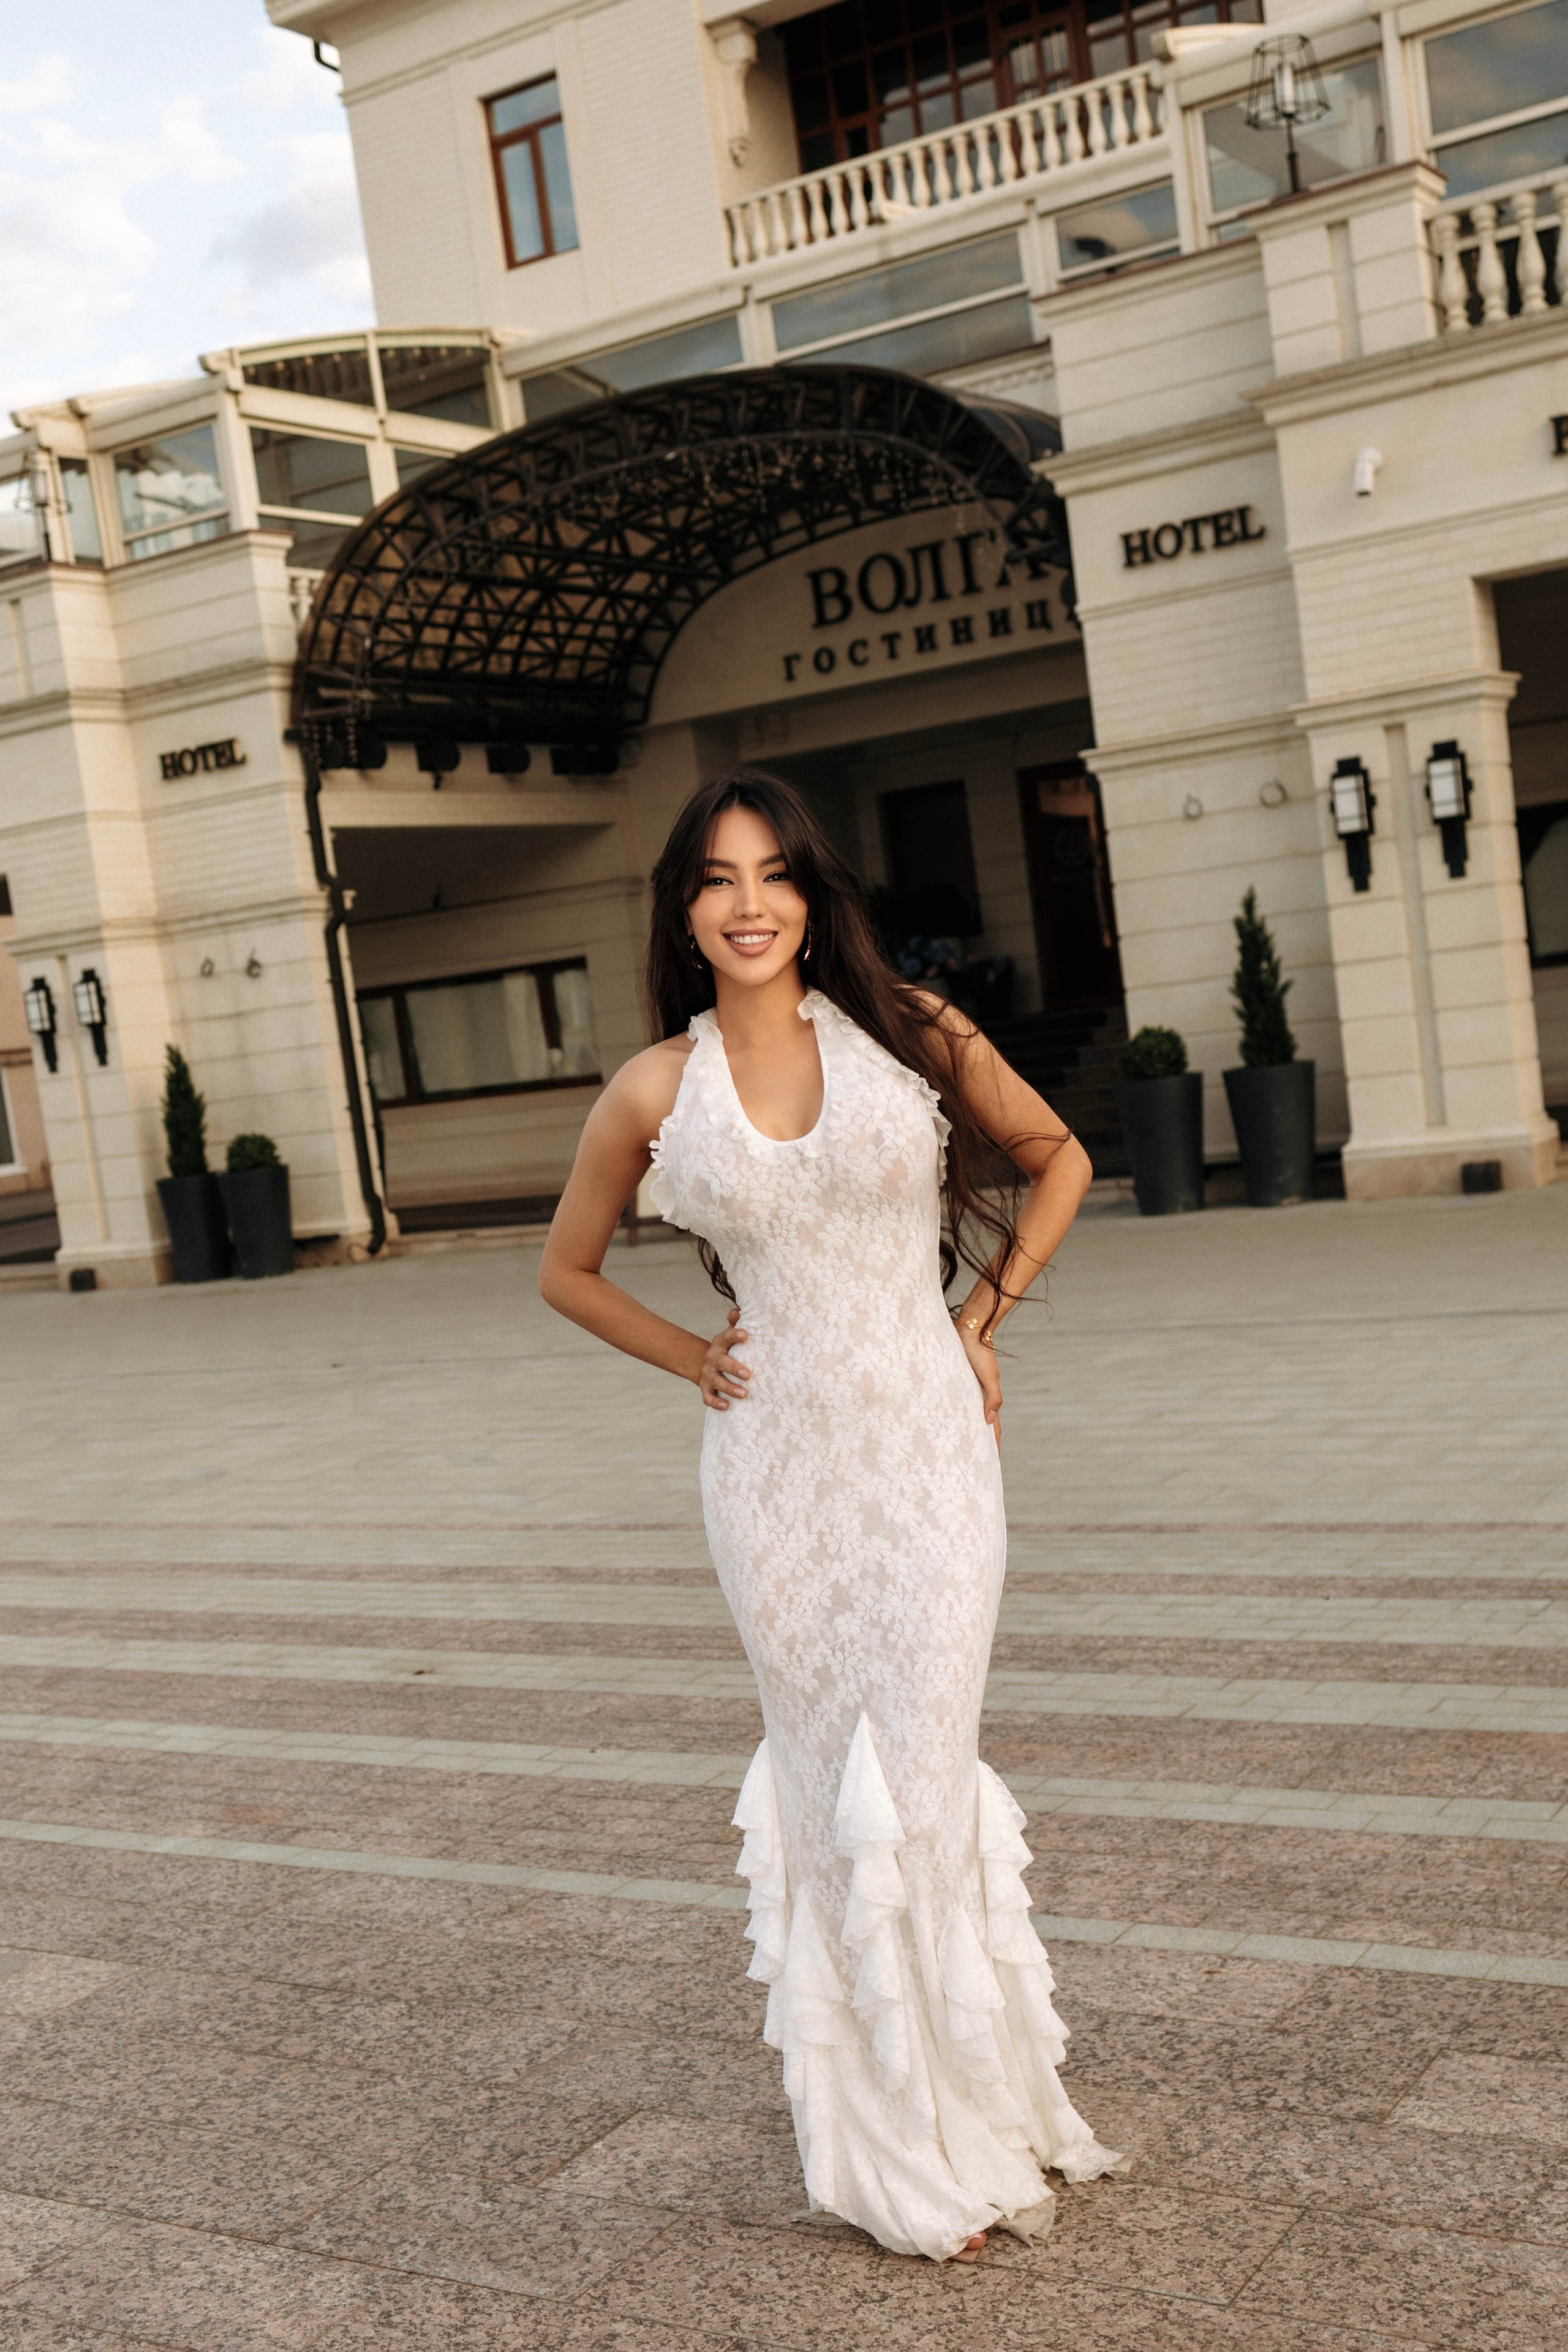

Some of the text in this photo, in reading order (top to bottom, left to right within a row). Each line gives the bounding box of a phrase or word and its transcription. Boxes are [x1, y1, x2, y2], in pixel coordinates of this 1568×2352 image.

[1121, 503, 1266, 568] HOTEL
[783, 598, 1080, 682] ГОСТИНИЦ
[159, 737, 247, 780] HOTEL
